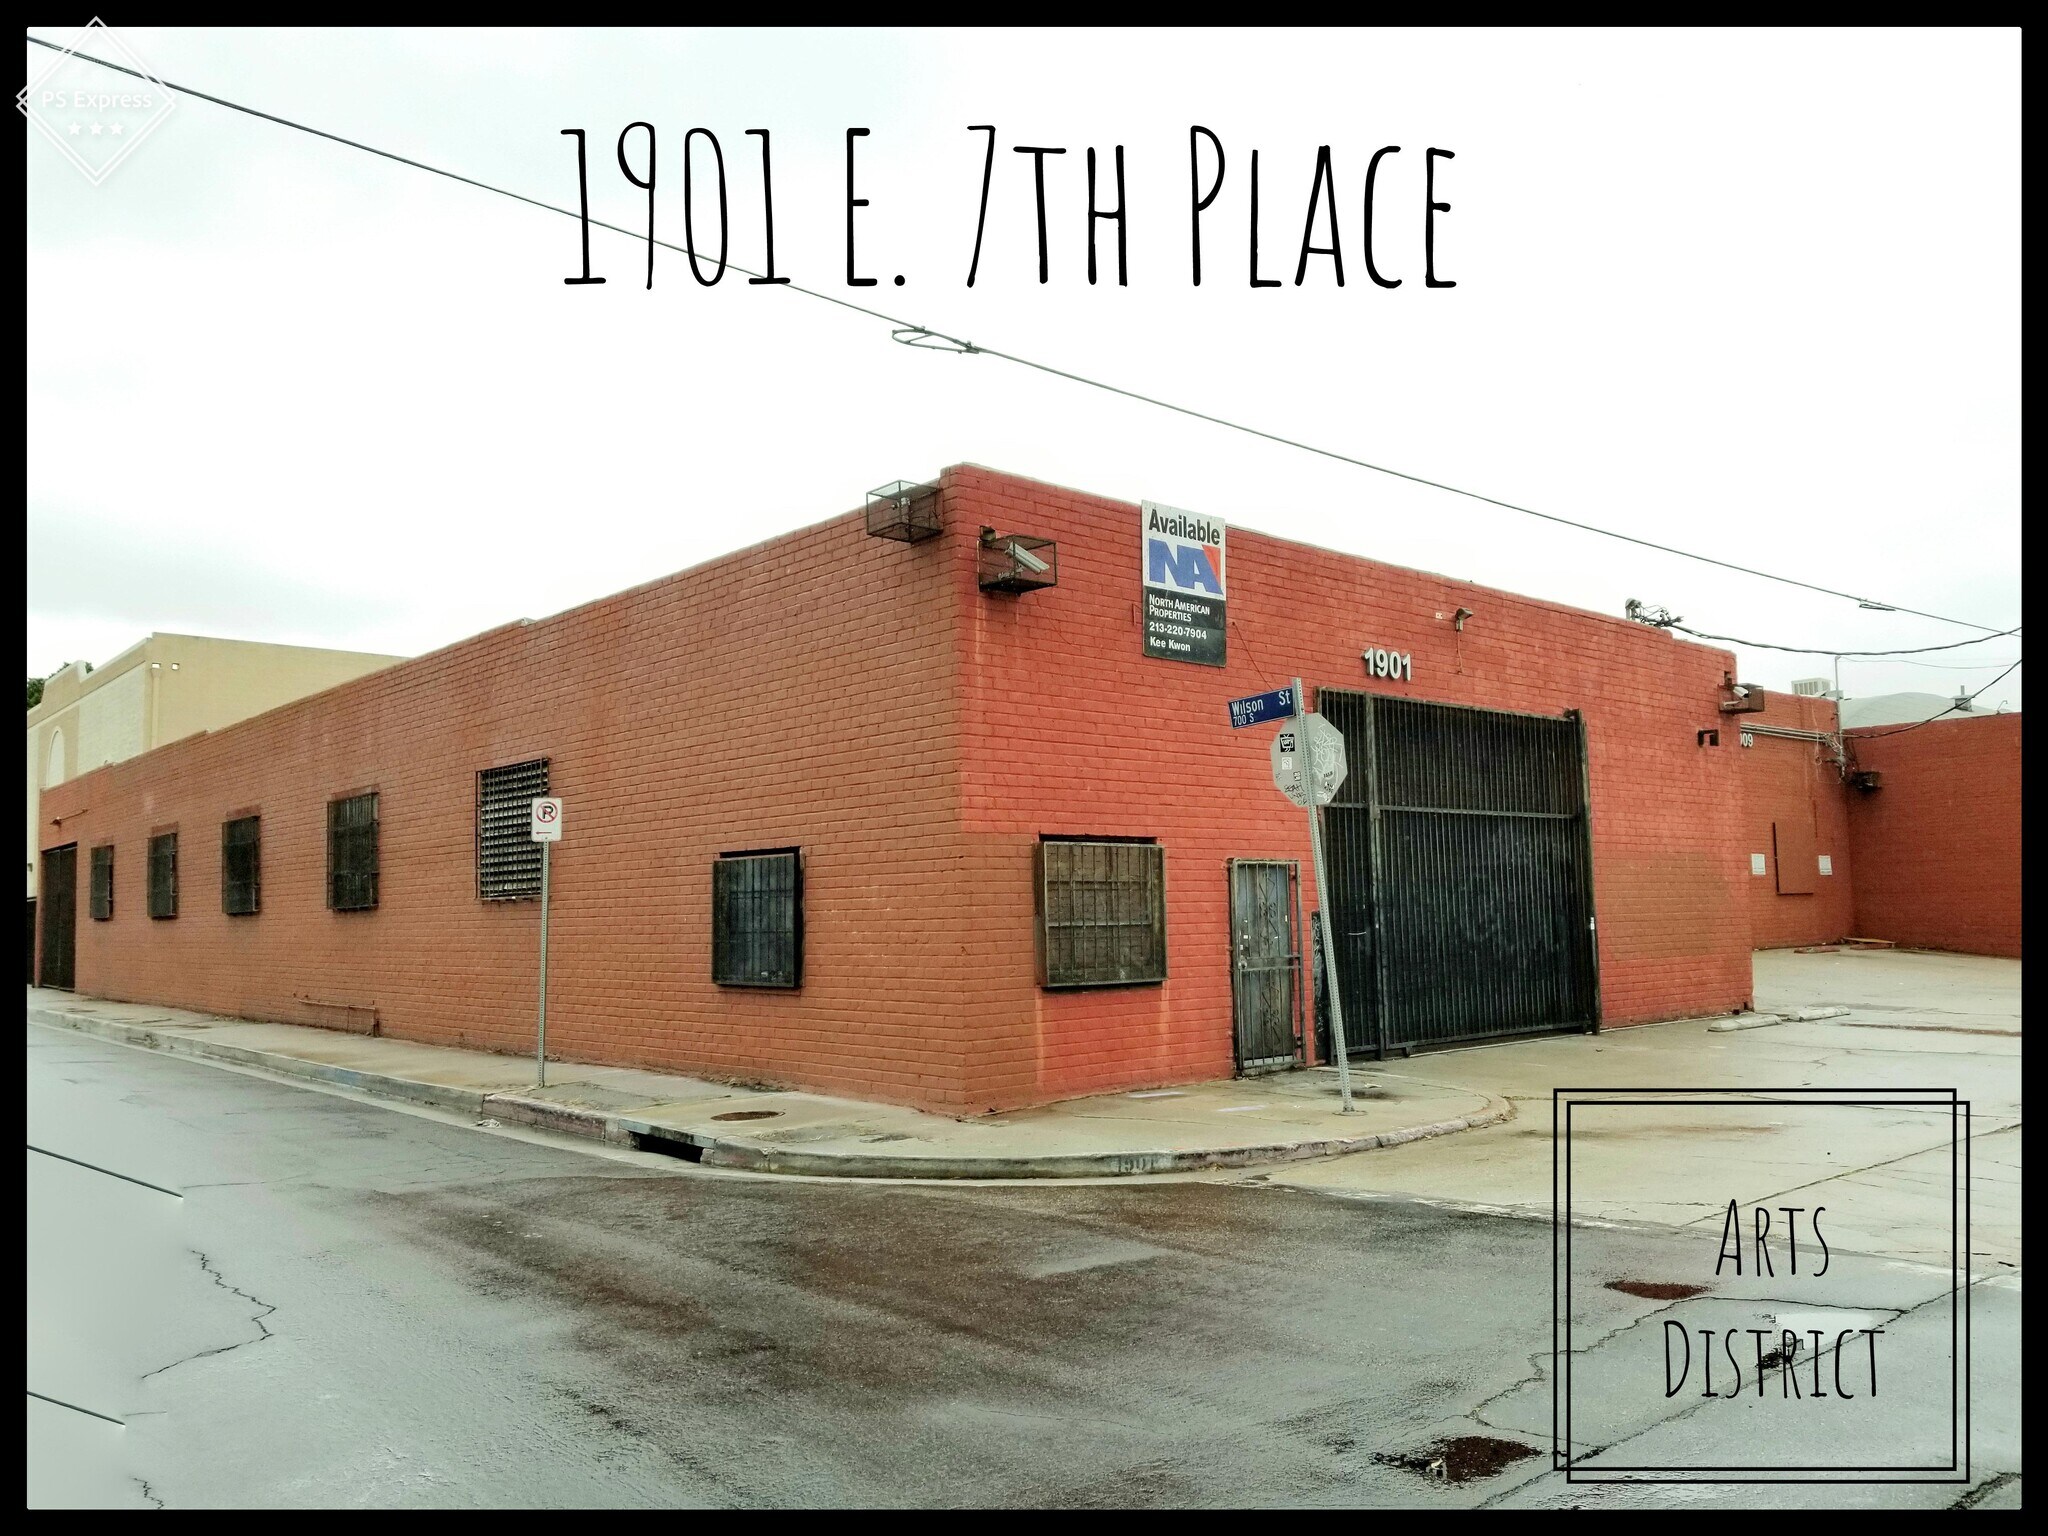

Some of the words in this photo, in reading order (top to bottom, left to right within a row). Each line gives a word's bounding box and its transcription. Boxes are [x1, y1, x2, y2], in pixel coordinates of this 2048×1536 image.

[1149, 509, 1221, 545] Available
[1150, 636, 1166, 648] Kee
[1168, 638, 1191, 652] Kwon
[1363, 646, 1412, 682] 1901
[1231, 699, 1264, 716] Wilson
[1278, 690, 1291, 706] St
[1232, 714, 1247, 727] 700
[1249, 712, 1255, 723] S
